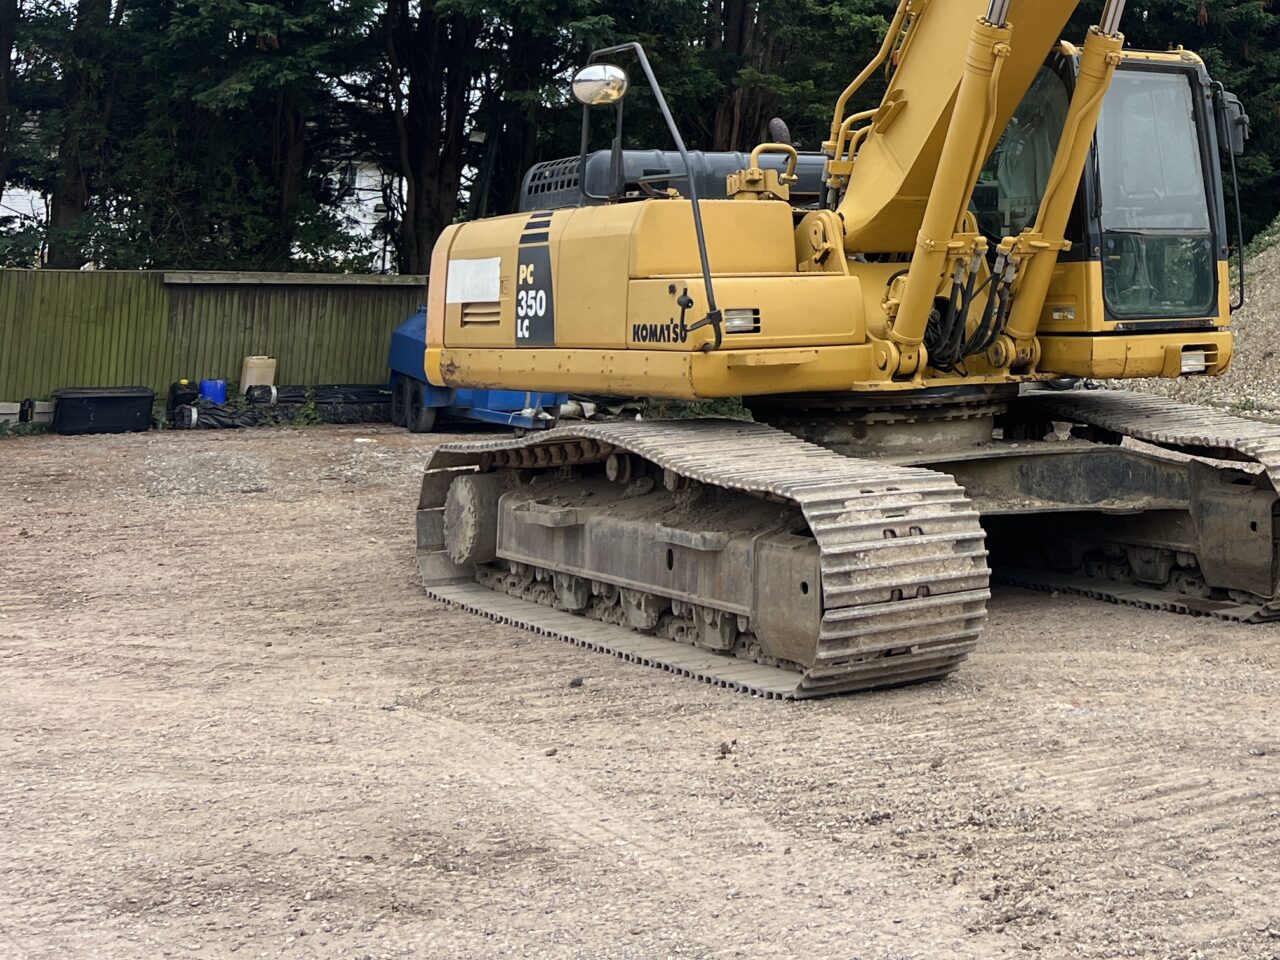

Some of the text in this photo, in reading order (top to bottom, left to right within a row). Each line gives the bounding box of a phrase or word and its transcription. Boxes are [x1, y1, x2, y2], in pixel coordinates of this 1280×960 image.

[519, 263, 534, 285] PC
[517, 289, 546, 317] 350
[517, 318, 530, 338] LC
